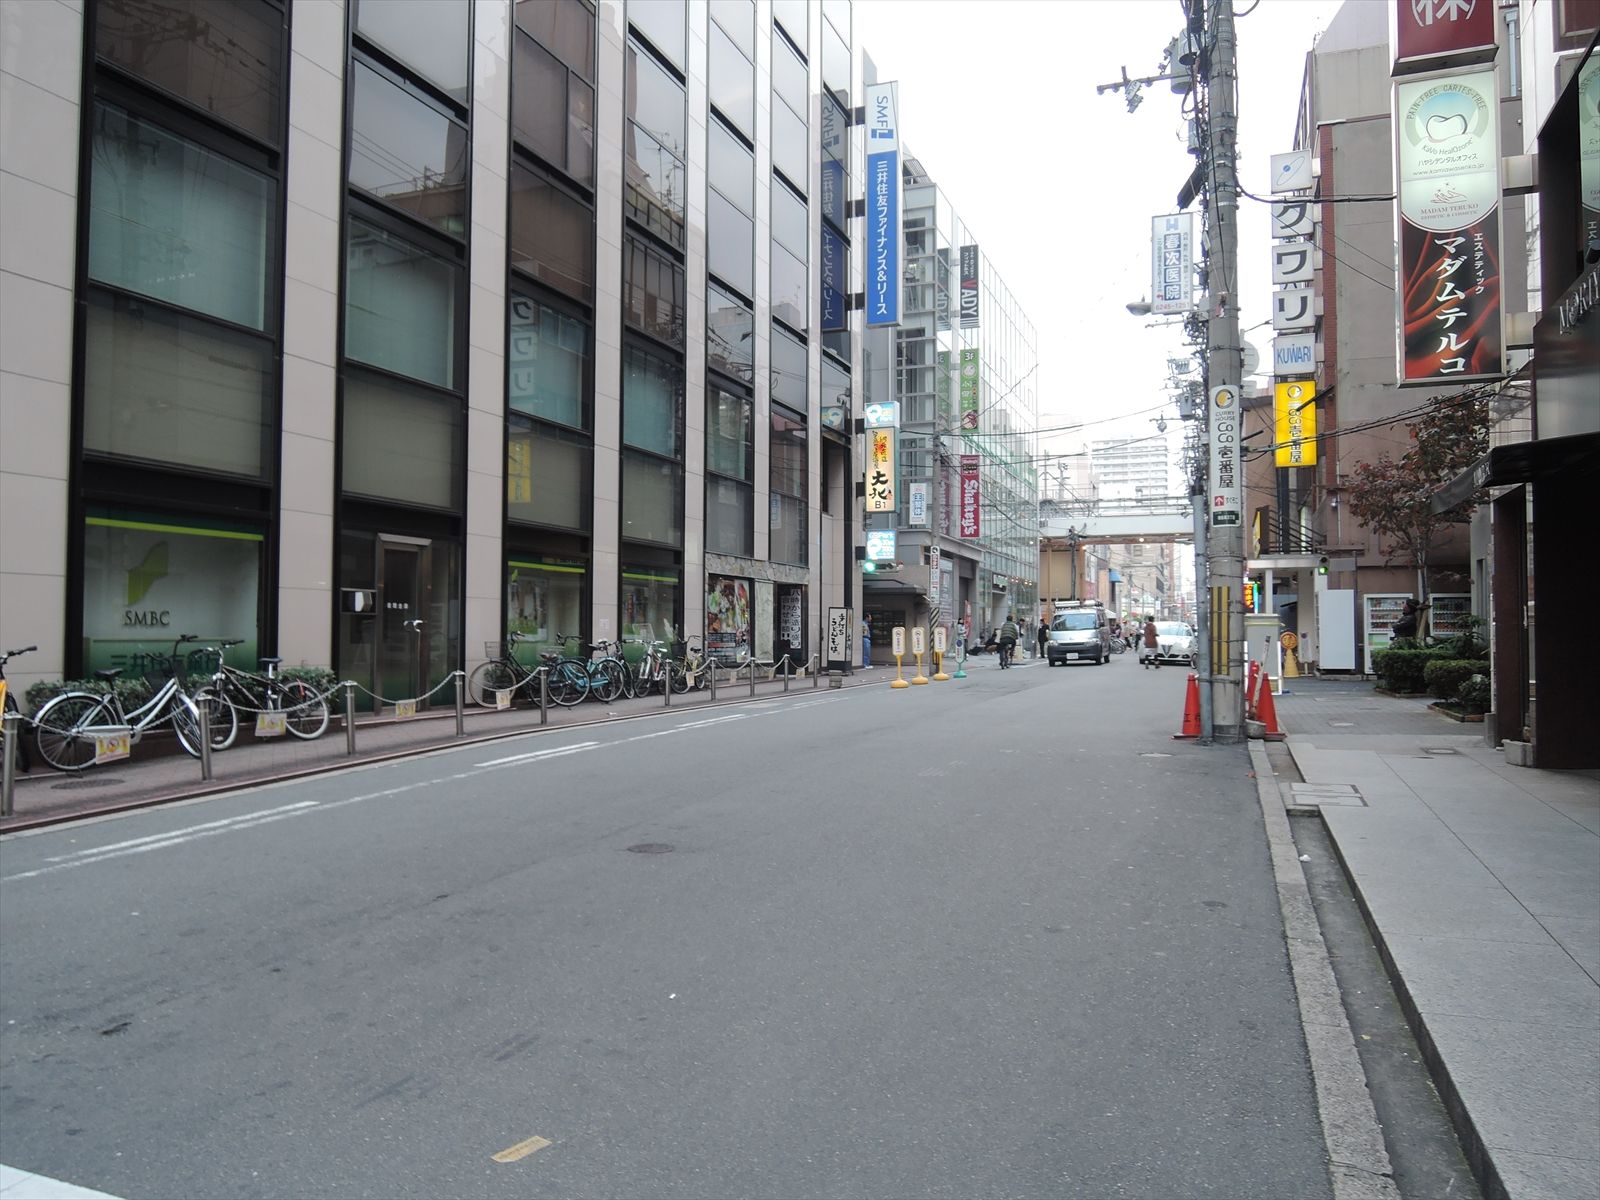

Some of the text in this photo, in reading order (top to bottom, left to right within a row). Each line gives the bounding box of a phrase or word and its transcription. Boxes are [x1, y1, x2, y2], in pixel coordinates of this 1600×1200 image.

[1407, 87, 1439, 120] PAIN-FREE
[1420, 203, 1479, 215] MADAM TERUKO
[876, 160, 889, 315] 三井住友ファイナンス&リース
[1474, 232, 1484, 295] エステティック
[961, 277, 978, 315] VADY
[1434, 236, 1469, 375] マダムテルコ
[874, 500, 887, 509] B1
[961, 479, 979, 535] Shakey's
[124, 610, 170, 626] SMBC
